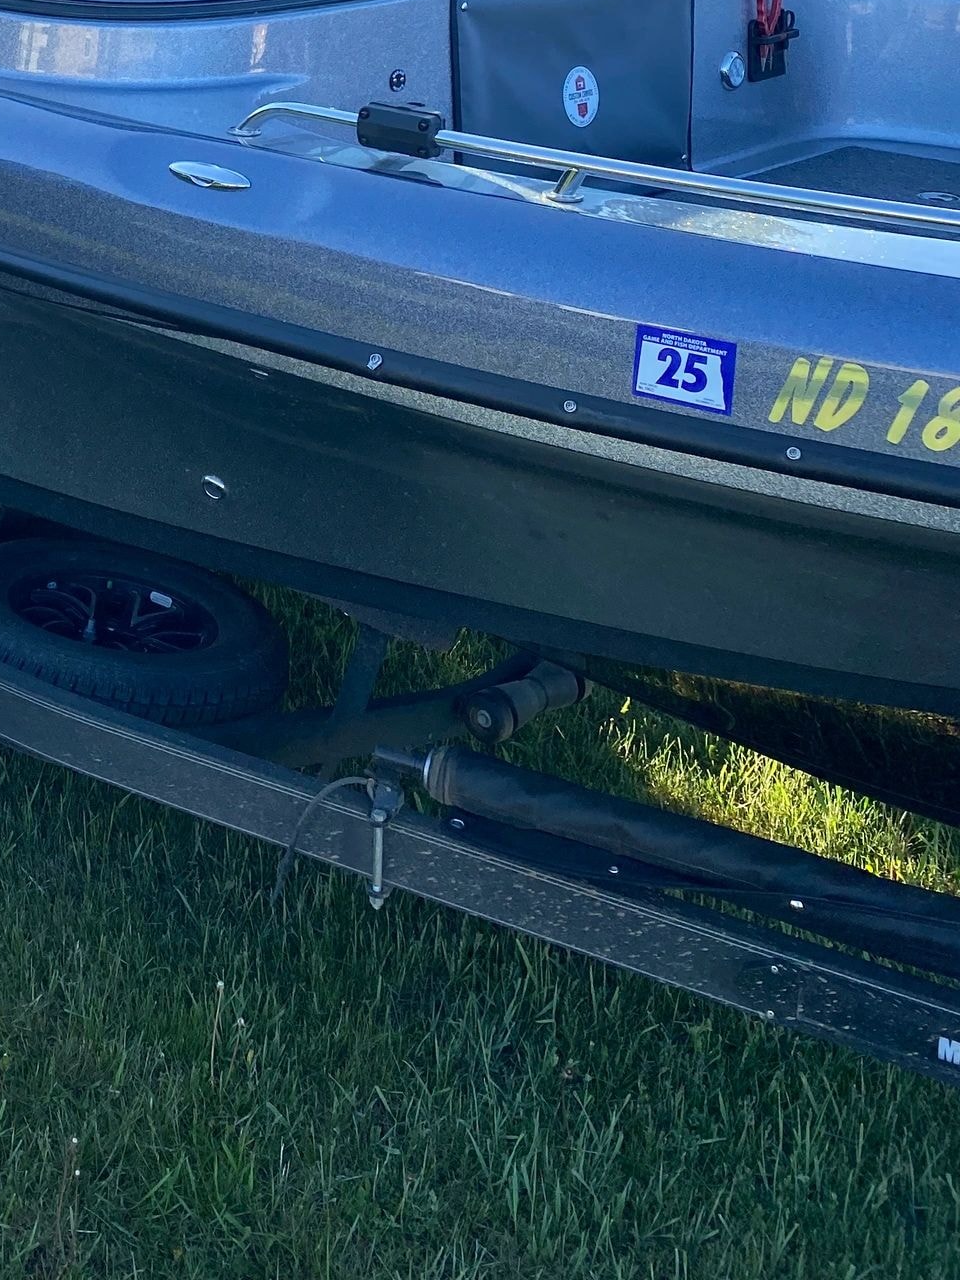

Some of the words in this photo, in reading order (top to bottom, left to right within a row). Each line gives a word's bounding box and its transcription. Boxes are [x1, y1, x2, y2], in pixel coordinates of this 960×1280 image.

[642, 334, 660, 343] GAME
[674, 341, 688, 349] FISH
[688, 344, 728, 356] DEPARTMENT
[661, 333, 683, 342] NORTH
[683, 336, 707, 347] DAKOTA
[656, 347, 708, 393] 25
[768, 357, 870, 432] ND
